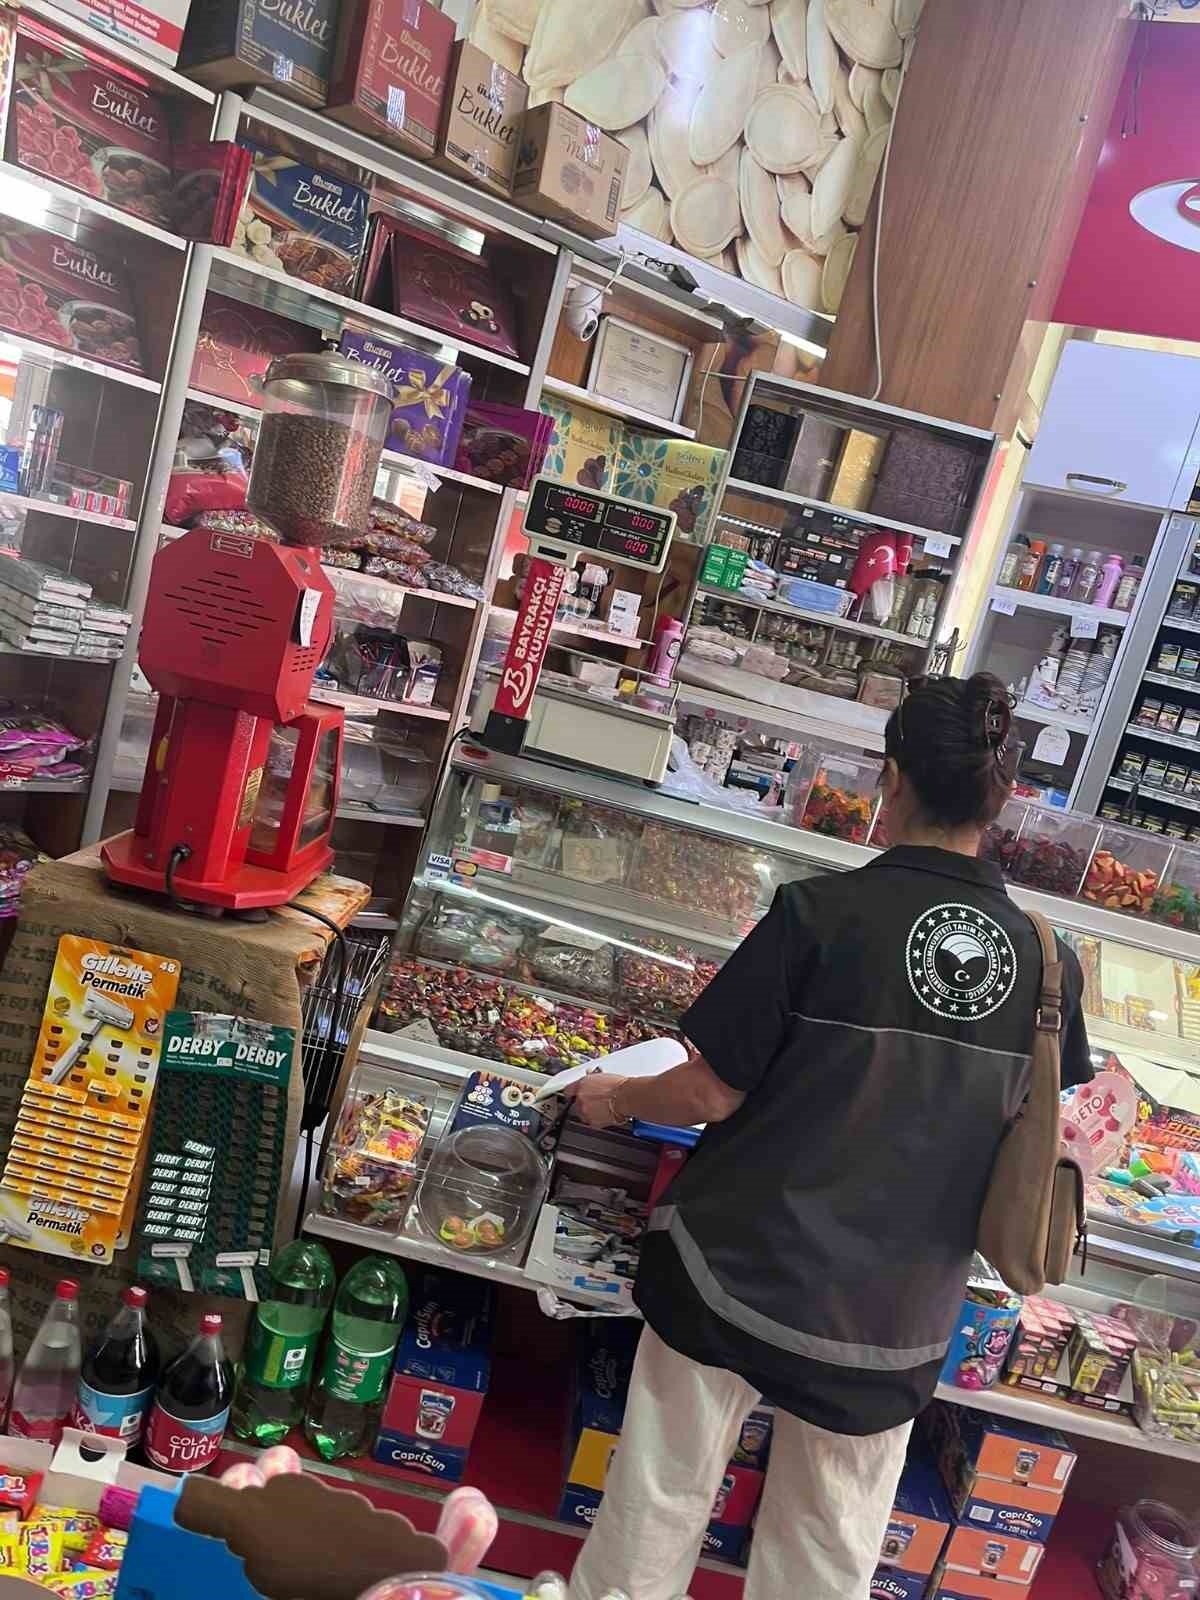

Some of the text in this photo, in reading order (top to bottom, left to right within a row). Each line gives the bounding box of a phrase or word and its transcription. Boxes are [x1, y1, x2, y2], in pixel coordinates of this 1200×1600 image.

[379, 31, 445, 96] Buklet
[93, 84, 160, 133] Buklet
[456, 85, 516, 146] Buklet
[295, 179, 357, 222] Buklet
[51, 244, 117, 287] Buklet
[514, 576, 548, 660] BAYRAKÇI
[431, 854, 451, 866] VISA
[953, 923, 977, 934] TARIM
[976, 931, 987, 942] VE
[985, 940, 999, 970] ORMAN
[81, 952, 154, 985] Gillette
[159, 961, 177, 975] 48
[81, 971, 147, 1000] Permatik
[167, 1034, 226, 1057] DERBY
[235, 1043, 288, 1069] DERBY
[512, 1119, 531, 1127] EYES
[184, 1139, 212, 1155] DERBY
[154, 1152, 212, 1170] DERBY DERBY
[152, 1167, 209, 1184] DERBY DERBY
[150, 1181, 207, 1197] DERBY DERBY
[149, 1195, 205, 1211] DERBY DERBY
[26, 1211, 83, 1236] Permatik
[147, 1210, 203, 1226] DERBY DERBY
[144, 1223, 201, 1240] DERBY DERBY
[416, 1301, 440, 1350] CapriSun
[169, 1435, 210, 1447] COLA
[391, 1449, 446, 1473] CapriSun
[998, 1509, 1043, 1527] CapriSun
[871, 1578, 908, 1598] priSun
